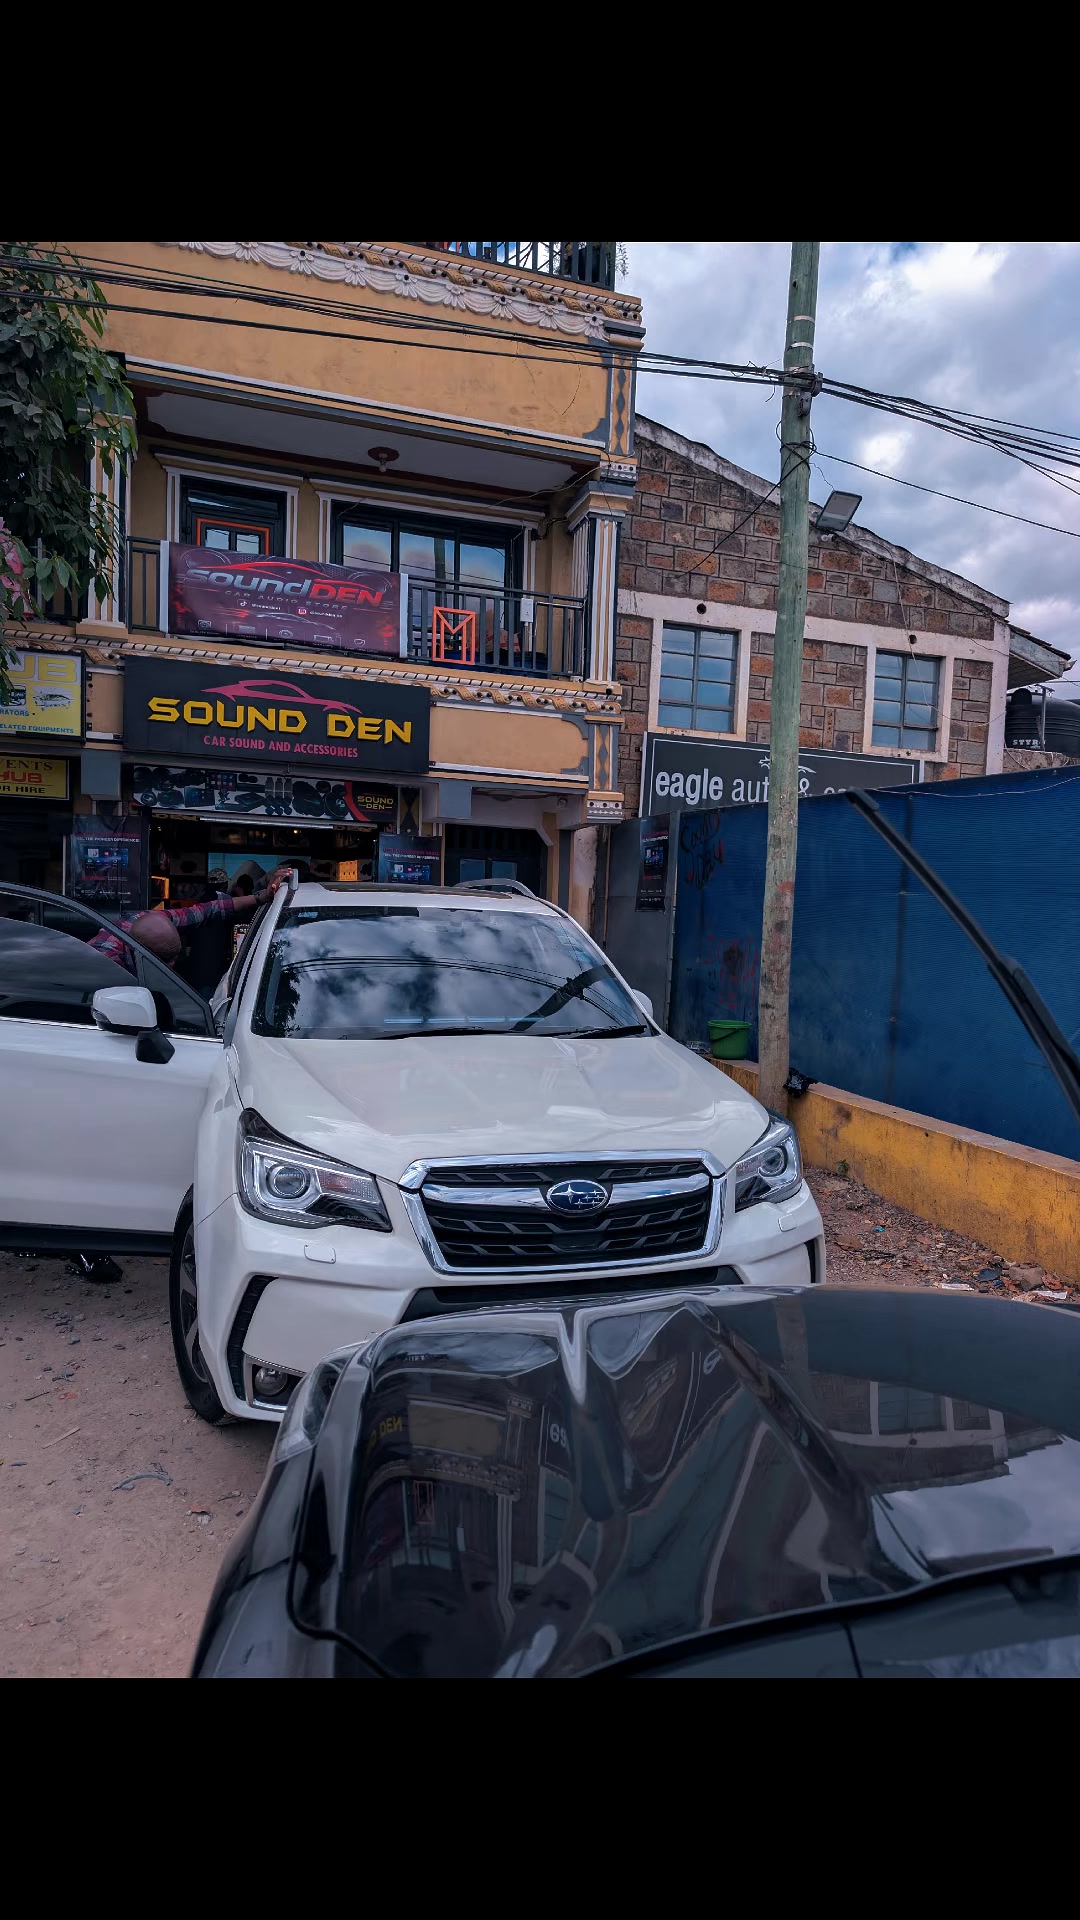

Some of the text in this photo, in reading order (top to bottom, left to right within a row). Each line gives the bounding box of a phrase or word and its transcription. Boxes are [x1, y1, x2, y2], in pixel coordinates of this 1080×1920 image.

[225, 590, 347, 610] CAR AUDIO STORE
[28, 725, 75, 734] EQUIPMENTS
[148, 697, 412, 745] SOUND DEN
[203, 735, 359, 758] CAR SOUND AND ACCESSORIES
[15, 786, 46, 794] HIRE
[655, 768, 724, 806] eagle
[731, 776, 770, 803] aut
[357, 795, 394, 805] SOUND
